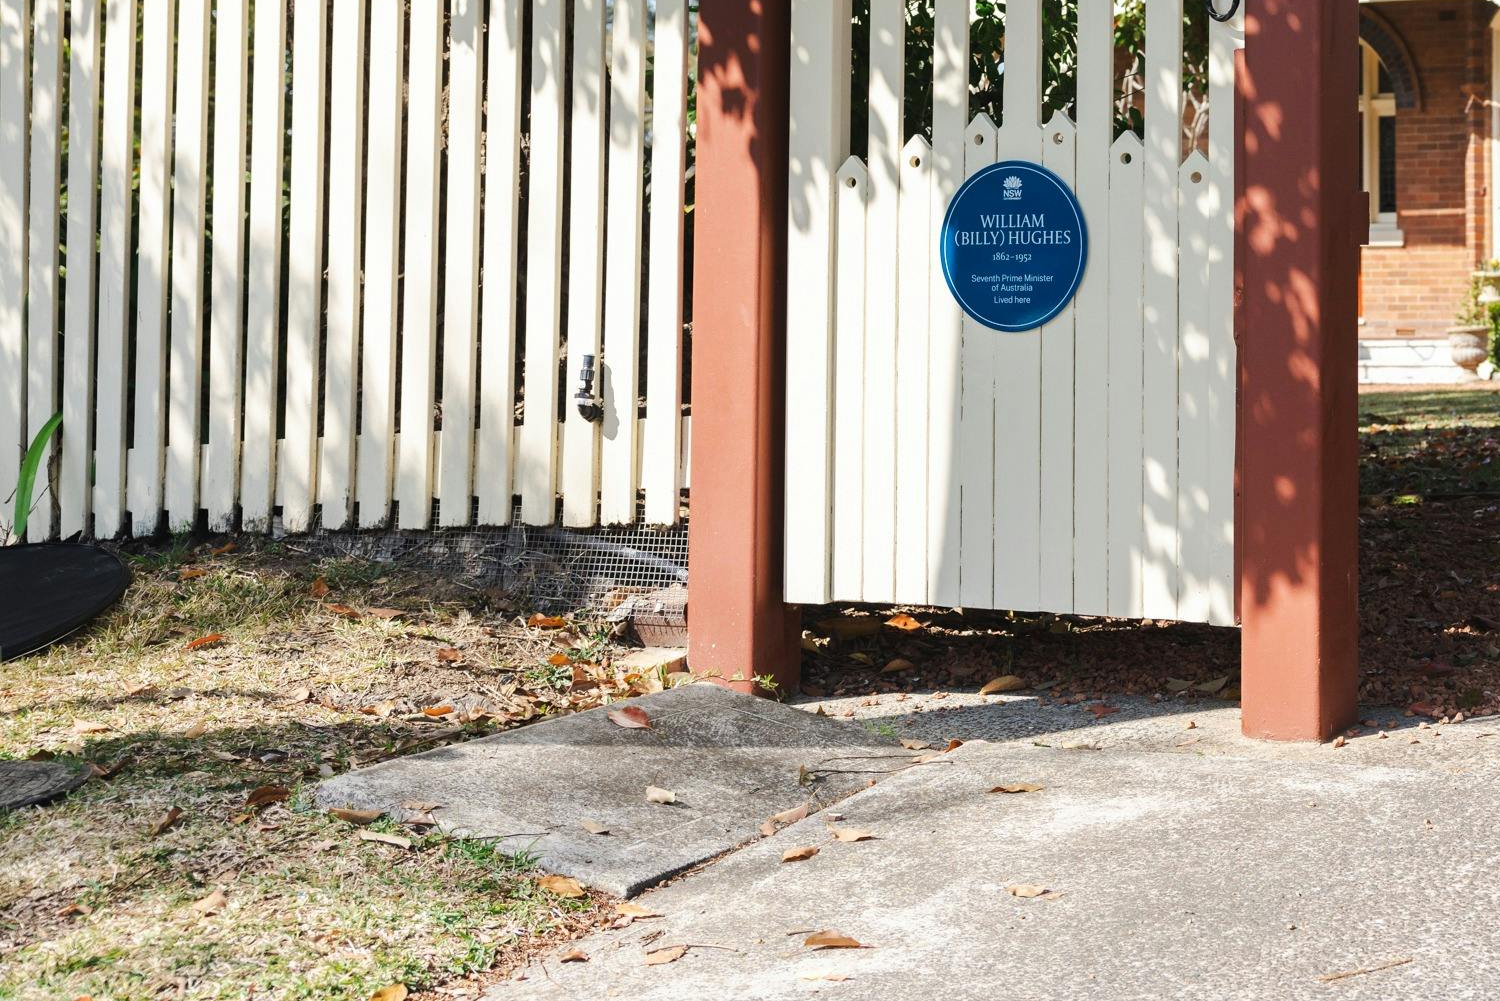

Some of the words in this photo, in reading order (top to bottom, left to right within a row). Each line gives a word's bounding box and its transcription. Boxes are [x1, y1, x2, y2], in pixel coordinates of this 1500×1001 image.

[1003, 190, 1022, 198] NSW
[980, 214, 1045, 228] WILLIAM
[955, 229, 1005, 247] (BILLY)
[1008, 230, 1071, 245] HUGHES
[971, 274, 1001, 283] Seventh
[1001, 274, 1023, 282] Prime
[1024, 273, 1054, 282] Minister
[991, 283, 999, 292] of
[1000, 283, 1033, 292] Australia
[993, 296, 1013, 304] Lived
[1014, 296, 1031, 304] here
